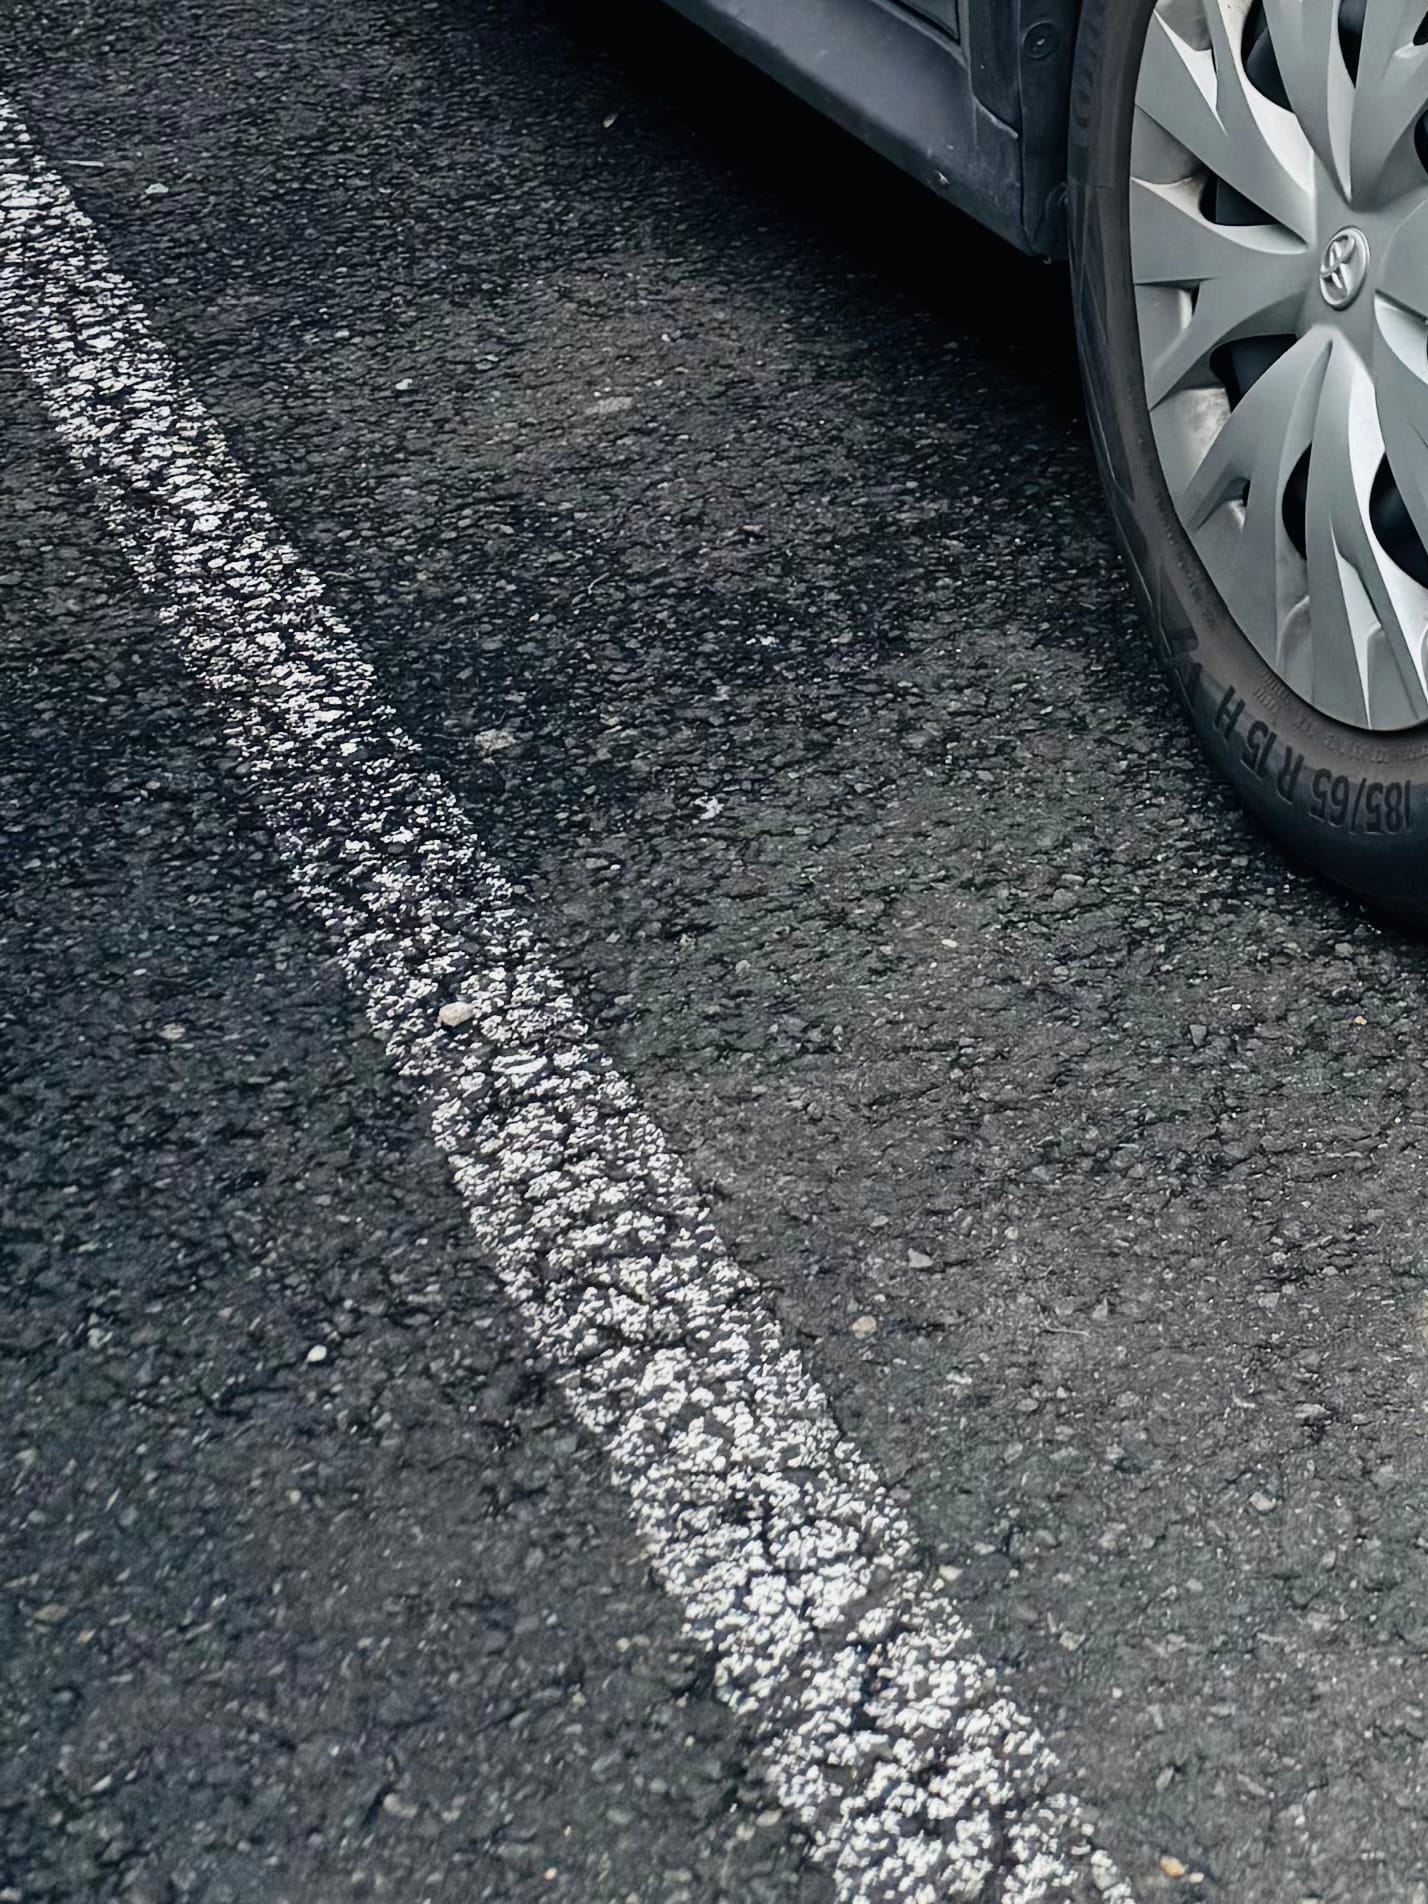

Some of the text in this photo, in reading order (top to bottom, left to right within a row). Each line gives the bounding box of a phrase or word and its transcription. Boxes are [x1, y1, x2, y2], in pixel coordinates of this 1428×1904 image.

[1213, 685, 1246, 740] H
[1240, 720, 1277, 781] 15
[1277, 746, 1304, 805] R
[1309, 769, 1411, 833] 185/65
